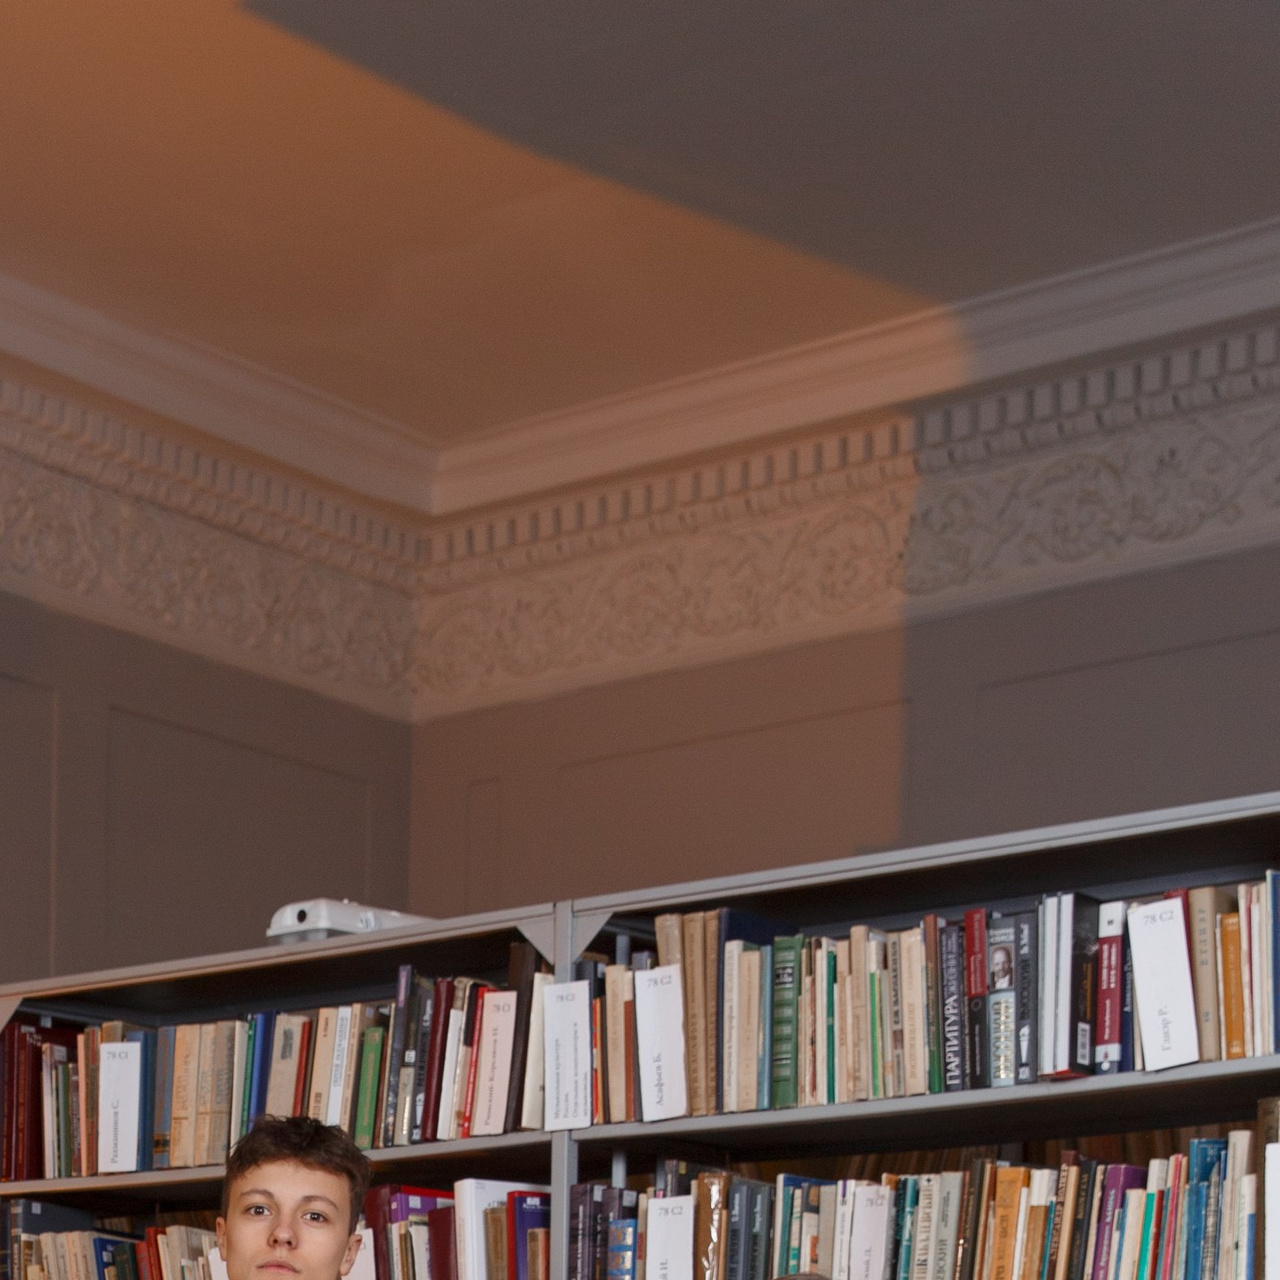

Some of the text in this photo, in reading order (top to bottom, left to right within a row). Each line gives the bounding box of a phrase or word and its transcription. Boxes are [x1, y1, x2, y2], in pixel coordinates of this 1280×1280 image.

[944, 994, 961, 1085] ПАРТИТУРА
[1158, 1017, 1172, 1051] Глиэр
[654, 1064, 666, 1108] Асафьев
[110, 1110, 119, 1164] Рахманинов
[658, 1258, 669, 1271] И.
